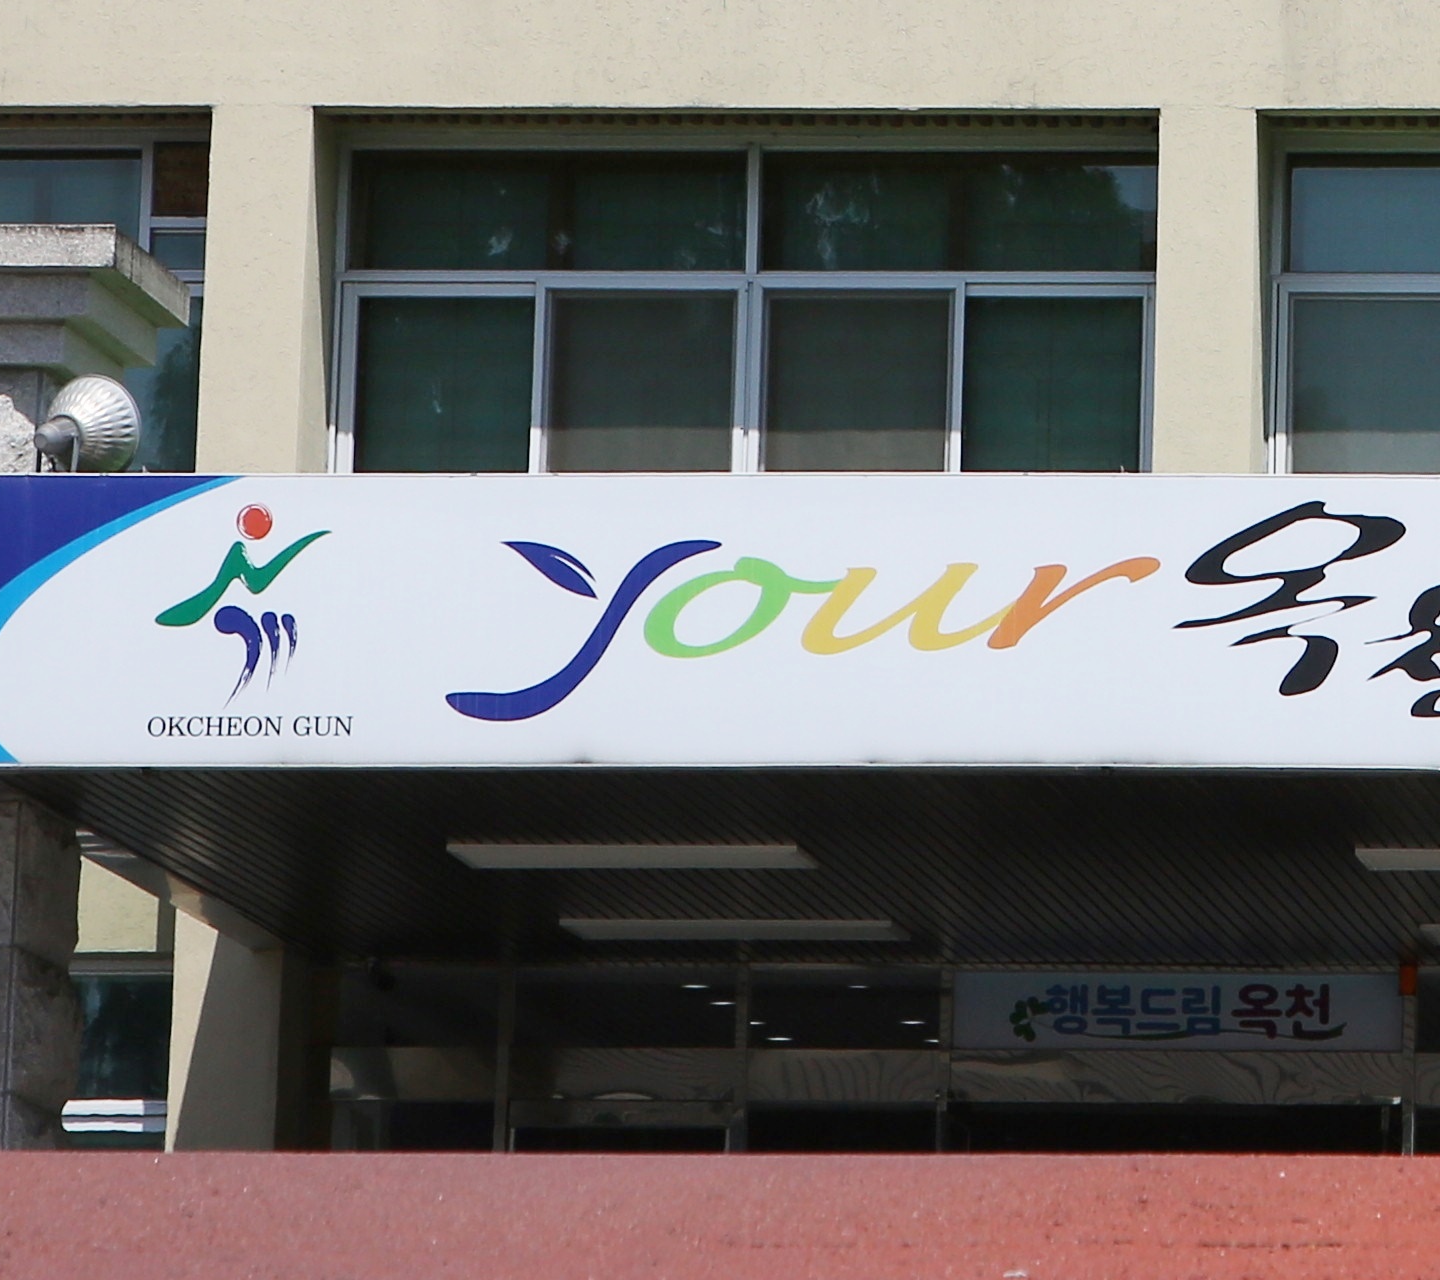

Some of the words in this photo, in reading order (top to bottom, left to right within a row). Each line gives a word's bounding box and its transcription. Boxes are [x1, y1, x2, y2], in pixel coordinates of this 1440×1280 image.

[445, 539, 1160, 720] your
[147, 716, 283, 737] OKCHEON
[292, 716, 353, 737] GUN
[1045, 983, 1222, 1036] 행복드림
[1231, 983, 1330, 1040] 옥천
